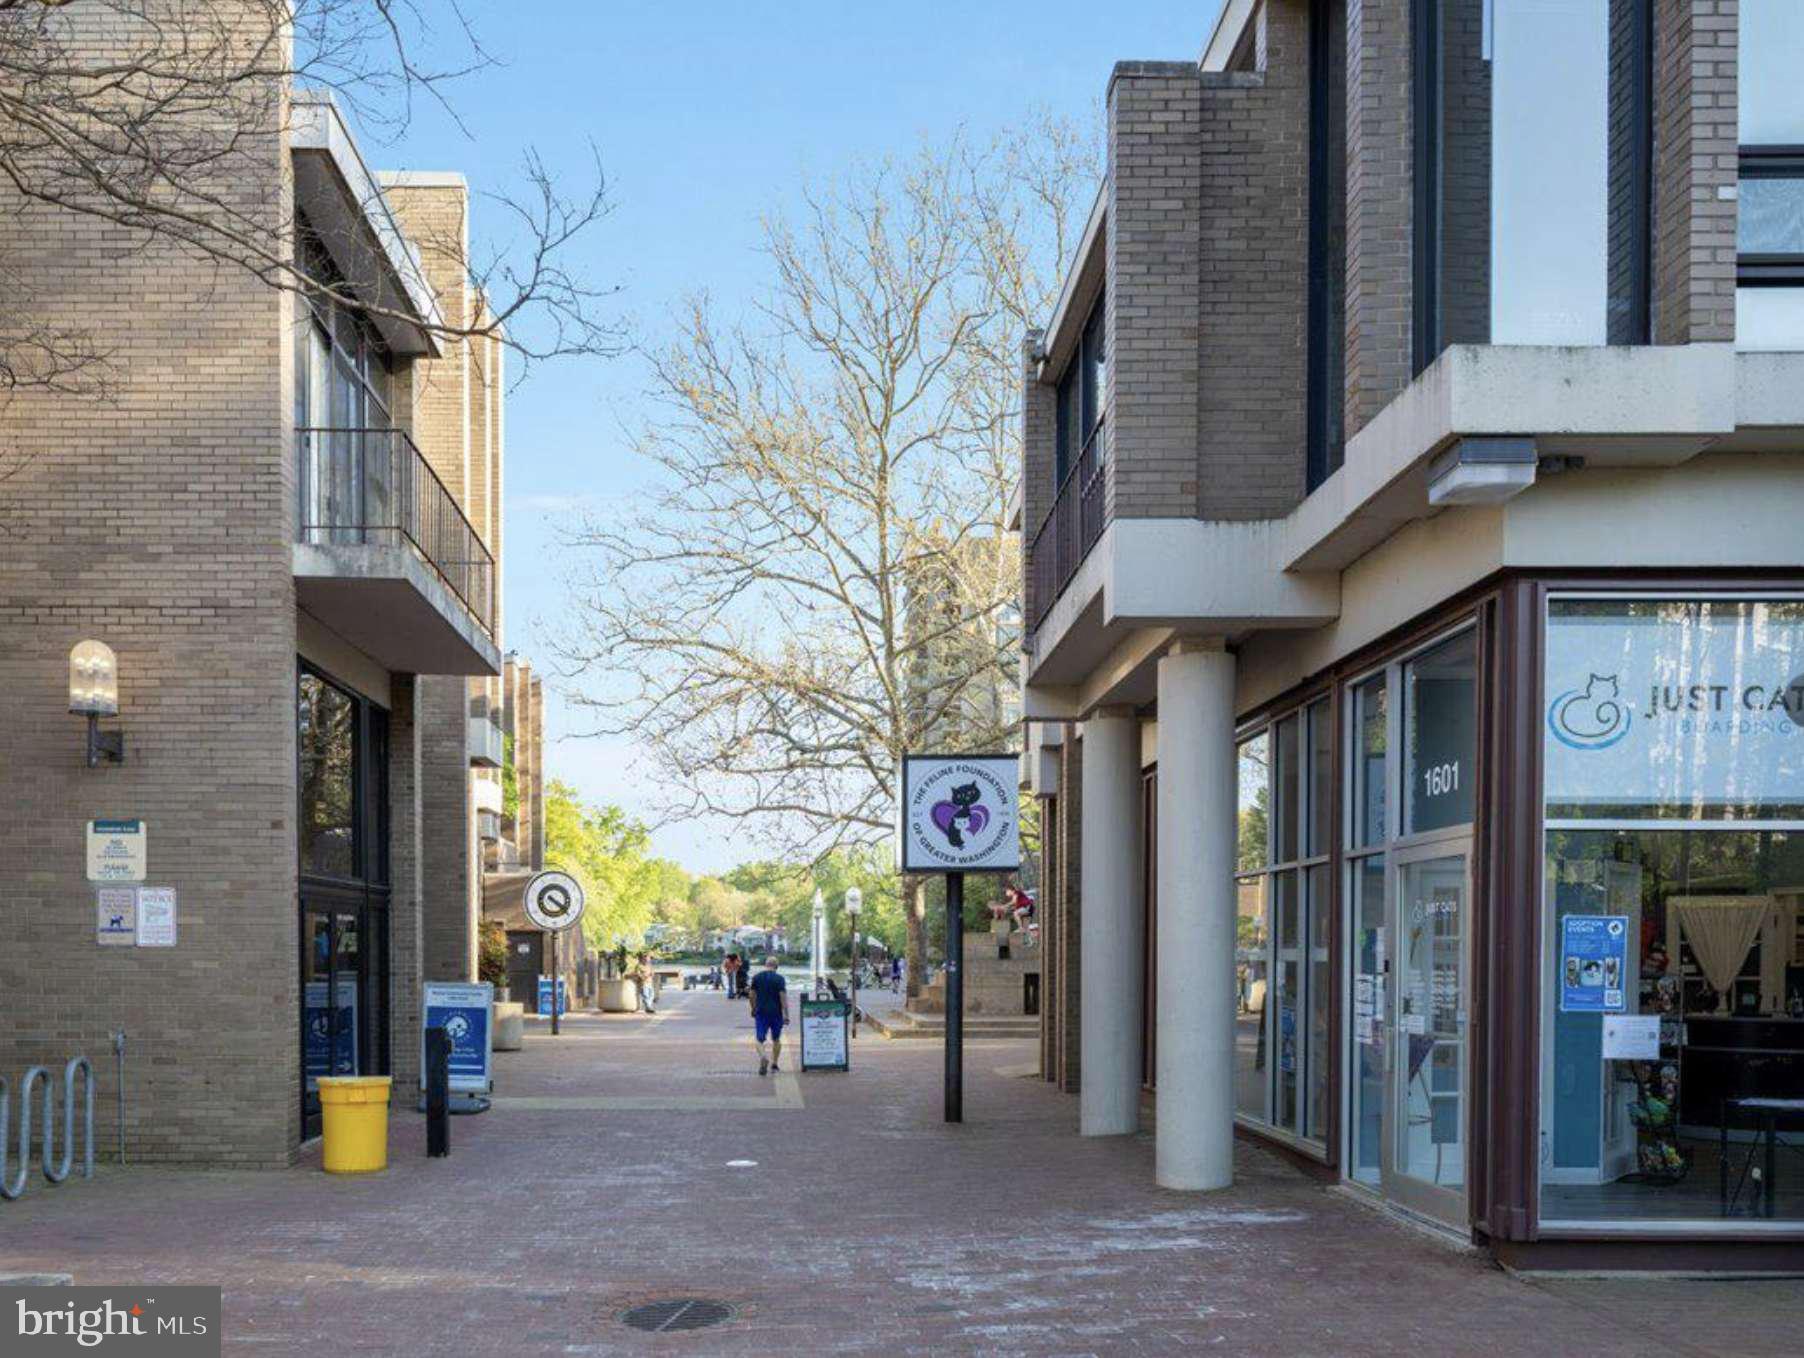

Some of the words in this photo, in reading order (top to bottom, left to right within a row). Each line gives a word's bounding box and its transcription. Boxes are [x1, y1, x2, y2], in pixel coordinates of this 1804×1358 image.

[1644, 685, 1728, 719] JUST
[913, 787, 926, 806] THE
[925, 766, 954, 788] FELINE
[956, 765, 1009, 805] FOUNDATION
[1424, 760, 1459, 797] 1601
[913, 822, 923, 835] OF
[920, 836, 956, 863] GREATER
[958, 822, 1010, 863] WASHINGTON
